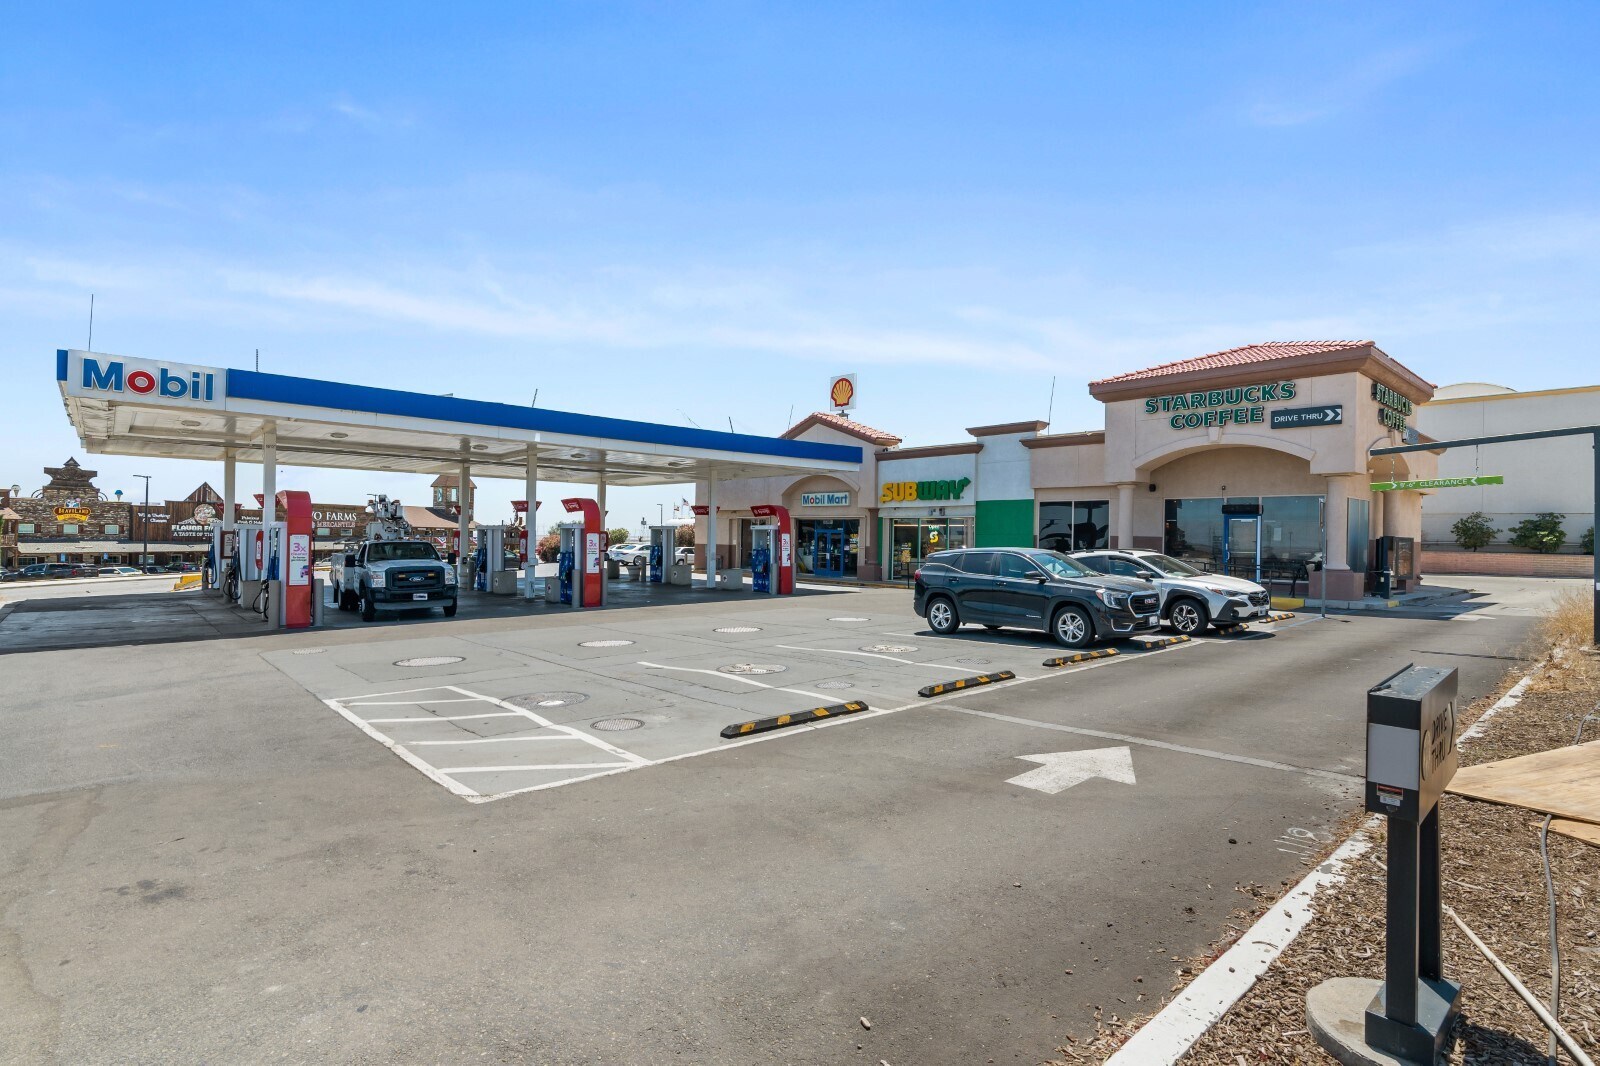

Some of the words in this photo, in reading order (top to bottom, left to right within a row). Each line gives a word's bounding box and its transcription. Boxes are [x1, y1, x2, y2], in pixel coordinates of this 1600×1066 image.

[82, 358, 214, 401] Mobil
[1145, 382, 1296, 414] STARBUCKS
[1376, 383, 1412, 415] STARBUCKS
[1170, 406, 1264, 430] COFFEE
[1274, 414, 1298, 423] DRIVE
[1301, 412, 1323, 421] THRU
[1384, 408, 1406, 433] COFFEE
[880, 477, 971, 503] SUBWAY
[1419, 478, 1468, 487] CLEARANCE
[803, 495, 825, 504] Mobil
[827, 494, 848, 504] Mart
[326, 512, 357, 521] FARMS
[293, 542, 307, 552] 3x
